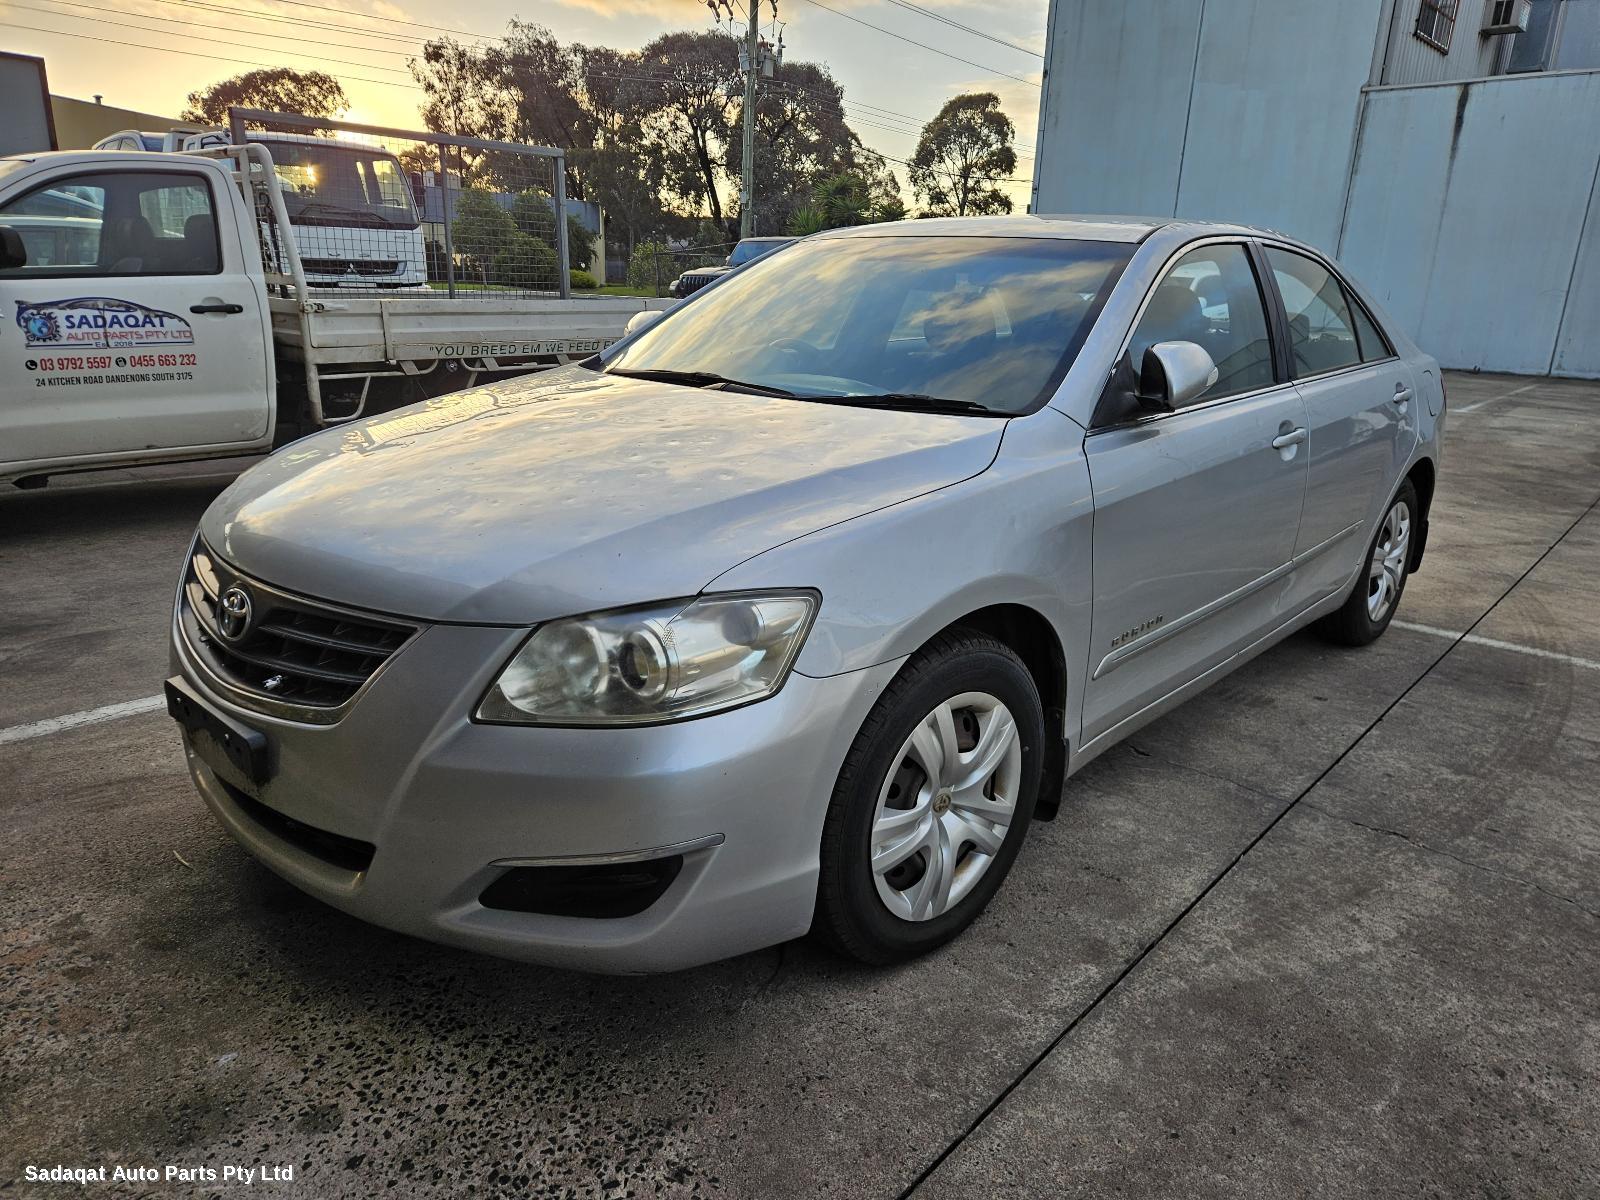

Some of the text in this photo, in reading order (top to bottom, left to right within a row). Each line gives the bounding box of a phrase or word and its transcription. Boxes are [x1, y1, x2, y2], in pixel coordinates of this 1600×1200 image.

[65, 314, 165, 328] SADAQAT
[66, 330, 194, 341] AUTO PARTS PTY LTD
[470, 344, 517, 355] BREED
[521, 343, 541, 354] EM
[545, 342, 564, 353] WE
[569, 341, 600, 351] FEED
[39, 353, 197, 372] 03 9792 5597 0455 663 232
[35, 371, 193, 387] 24 KITCHEN ROAD DANDENONG SOUTH 3175
